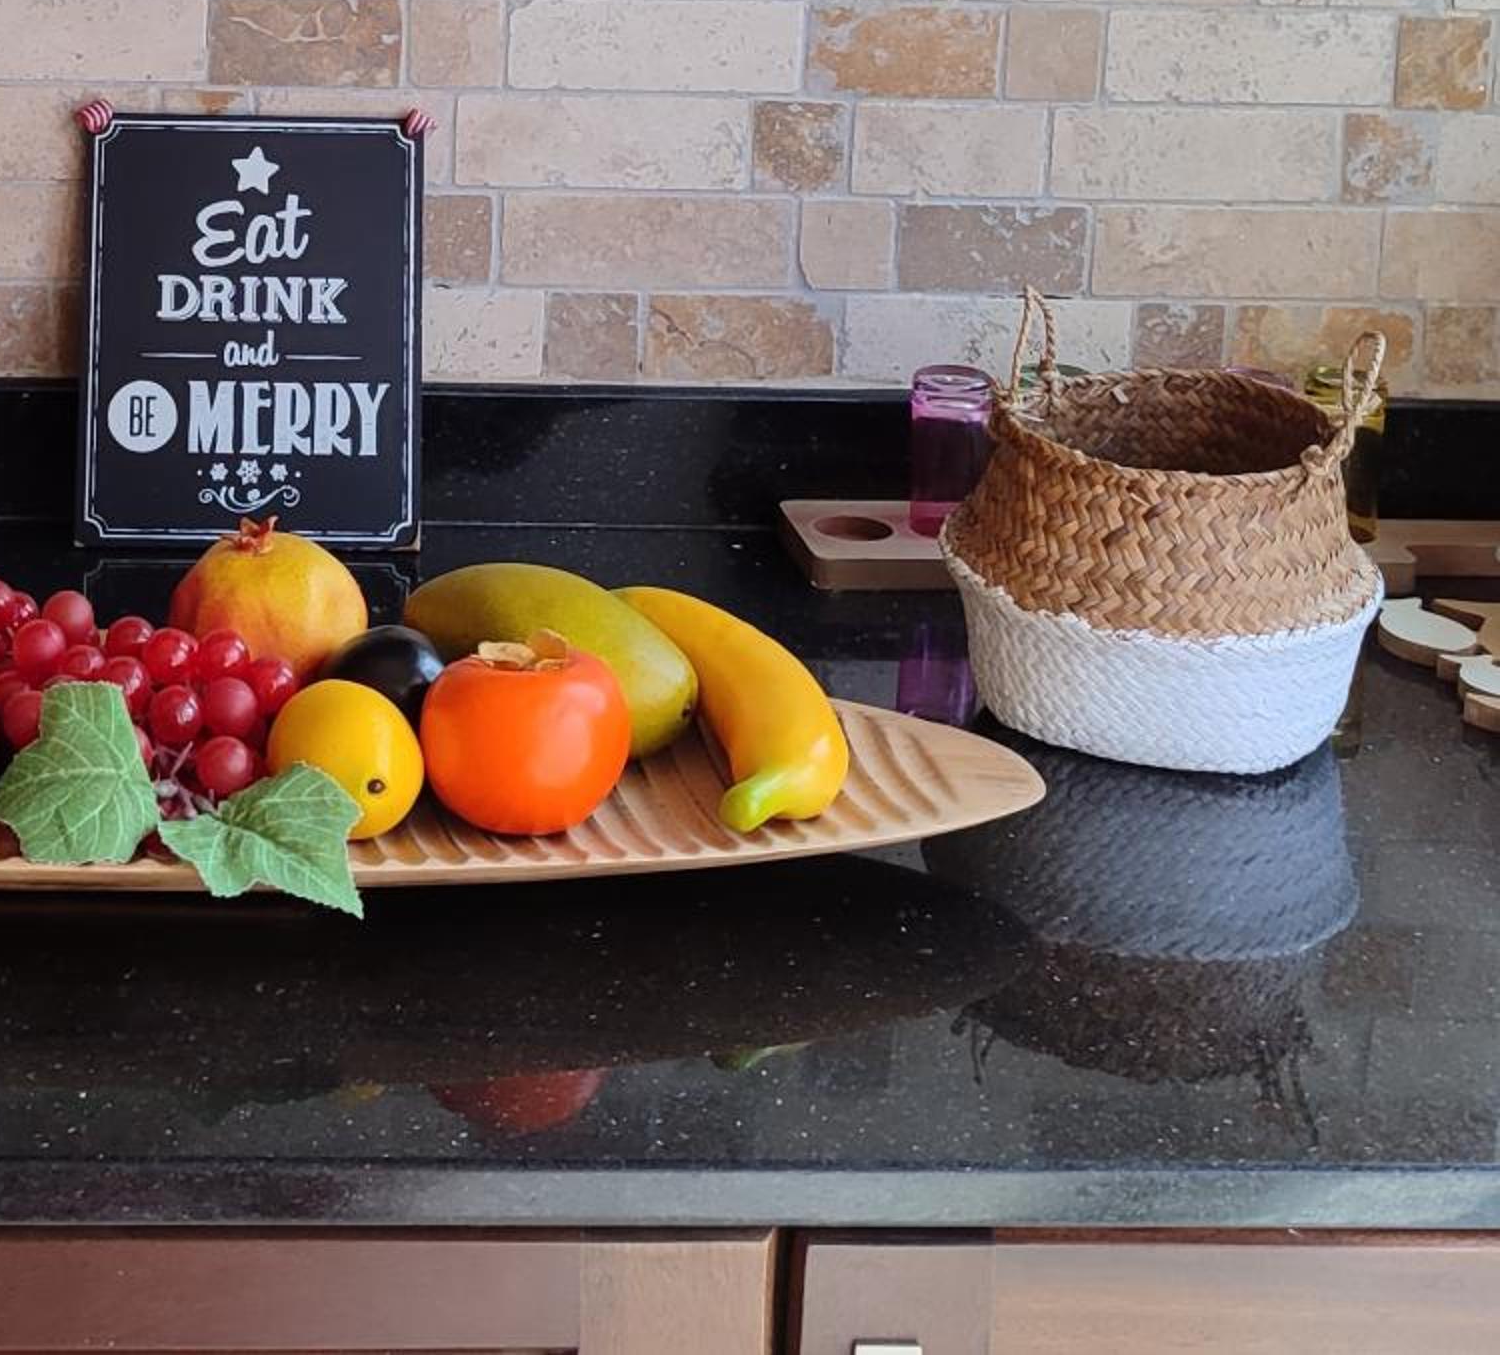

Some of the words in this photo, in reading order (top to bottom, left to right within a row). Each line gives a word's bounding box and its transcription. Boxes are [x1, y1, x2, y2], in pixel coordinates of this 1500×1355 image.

[192, 194, 311, 267] Eat
[156, 274, 348, 324] DRINK
[223, 330, 279, 367] and
[129, 396, 157, 437] BE
[187, 380, 391, 456] MERRY
